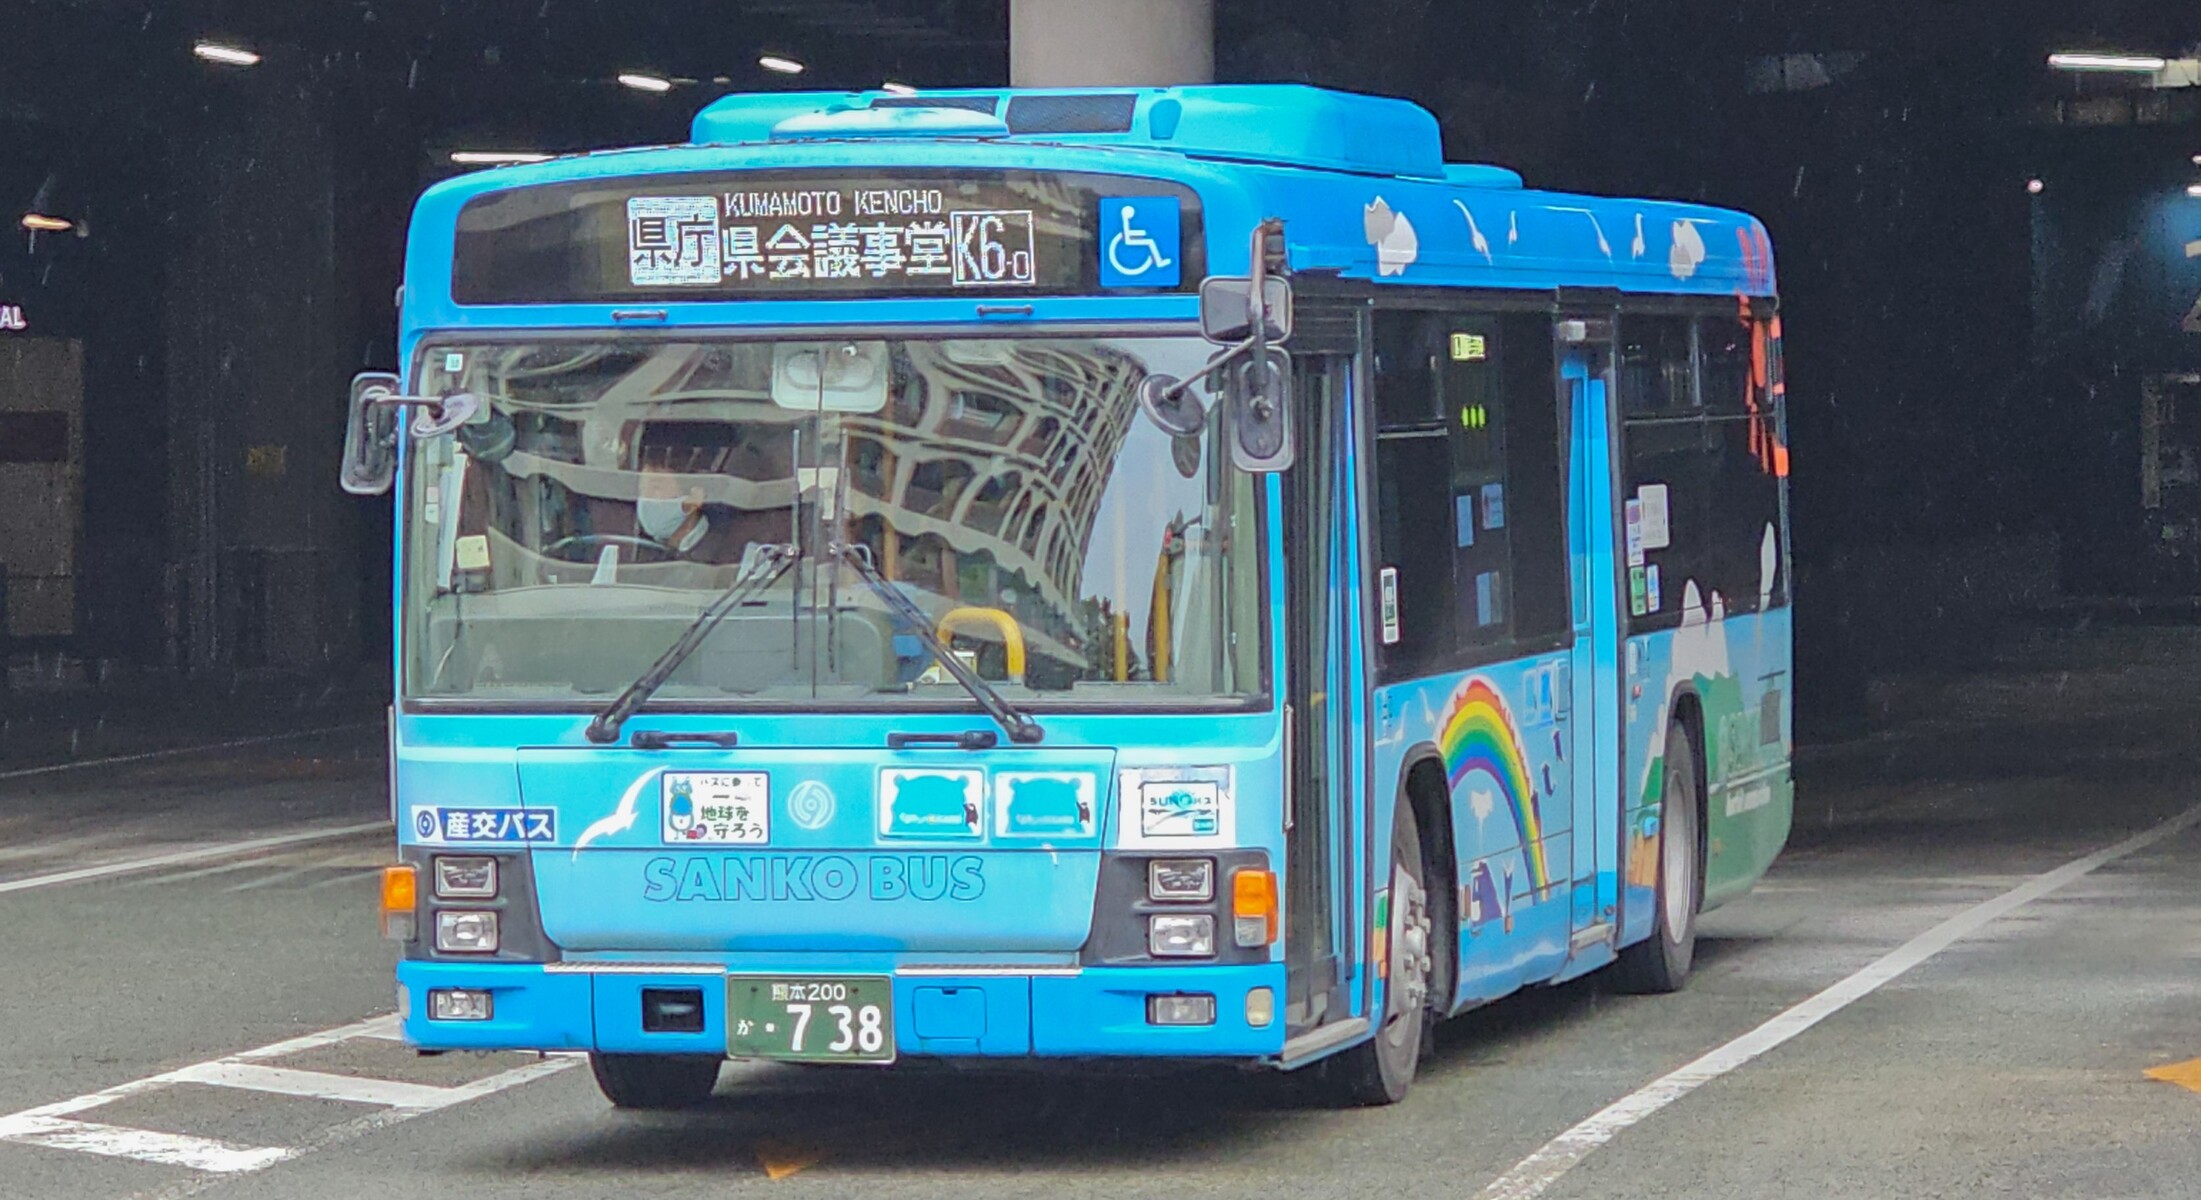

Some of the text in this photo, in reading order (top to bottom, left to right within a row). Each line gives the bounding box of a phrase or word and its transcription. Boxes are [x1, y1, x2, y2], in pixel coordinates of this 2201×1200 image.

[724, 190, 942, 217] KUMAMOTO KENCHO
[633, 213, 715, 268] 県庁
[722, 221, 951, 279] 県会議事堂
[447, 811, 552, 838] 産交バス
[701, 805, 749, 821] 地球を
[713, 823, 763, 839] 守ろう
[644, 856, 986, 901] SANKO BUS
